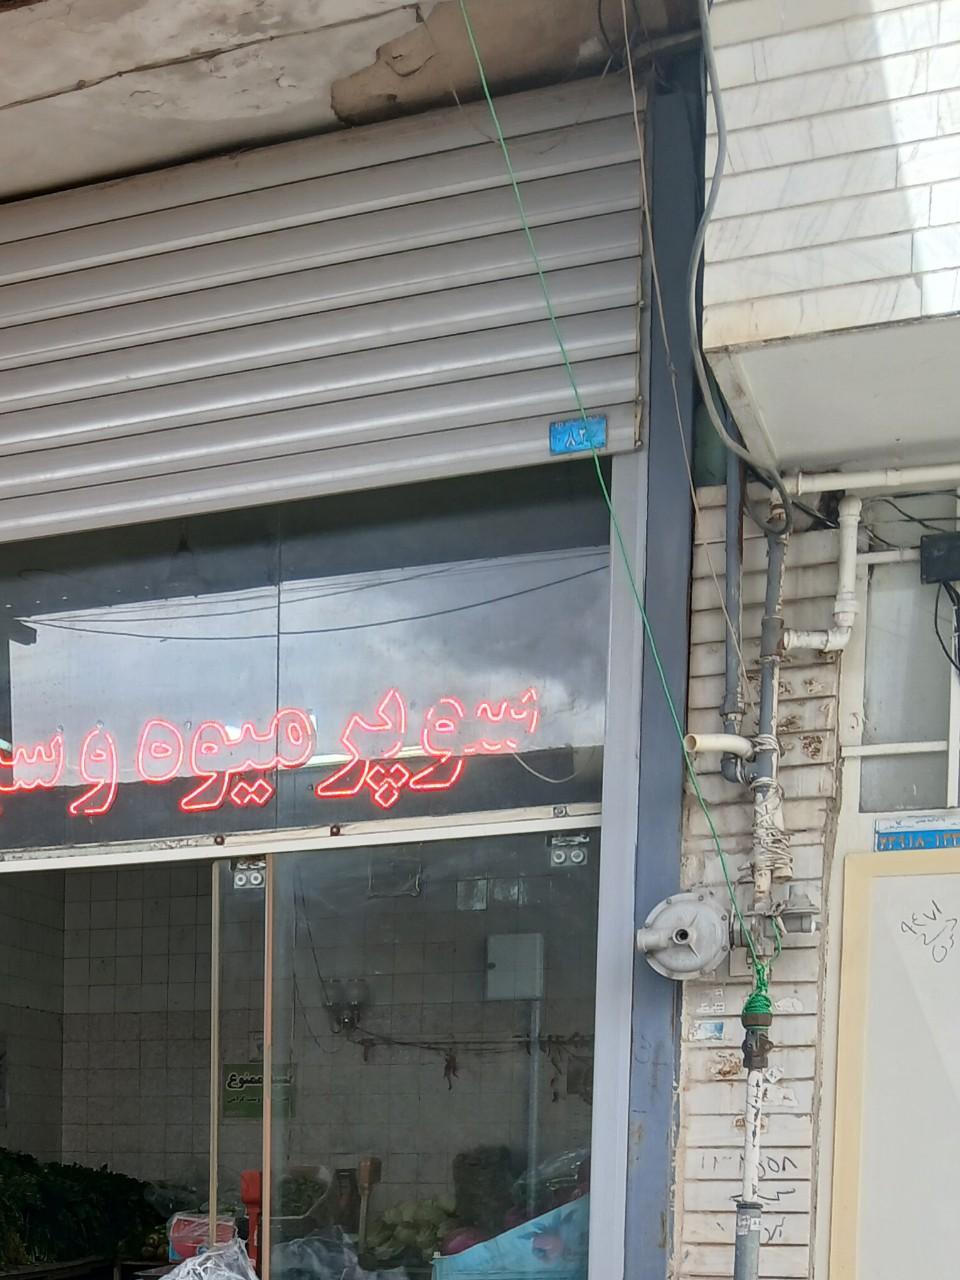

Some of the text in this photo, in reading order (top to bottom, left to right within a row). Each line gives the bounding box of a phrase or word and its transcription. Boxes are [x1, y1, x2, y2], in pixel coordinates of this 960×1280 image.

[69, 727, 118, 816] و
[139, 707, 317, 812] میوه
[317, 687, 540, 808] سوپر
